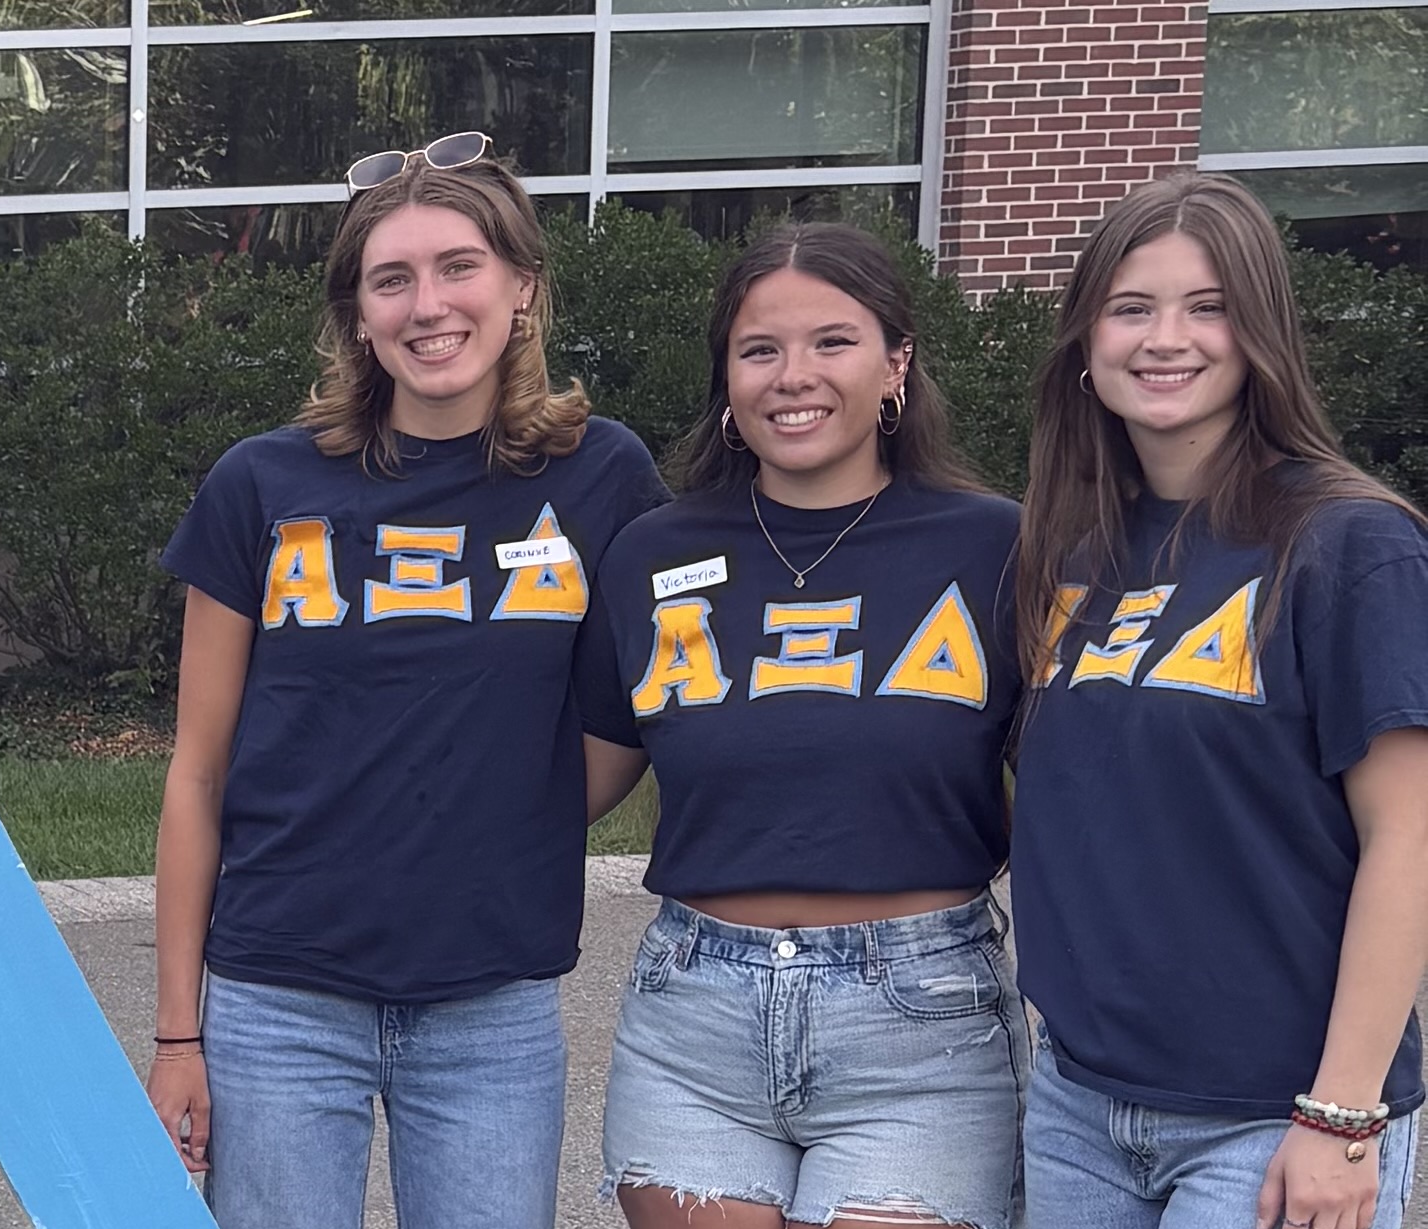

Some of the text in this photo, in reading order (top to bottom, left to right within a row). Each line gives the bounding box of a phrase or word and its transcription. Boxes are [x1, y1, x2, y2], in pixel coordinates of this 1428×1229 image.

[263, 502, 589, 630] ΑΞΔ
[660, 568, 720, 591] Victoria
[631, 581, 988, 717] ΑΞΔ
